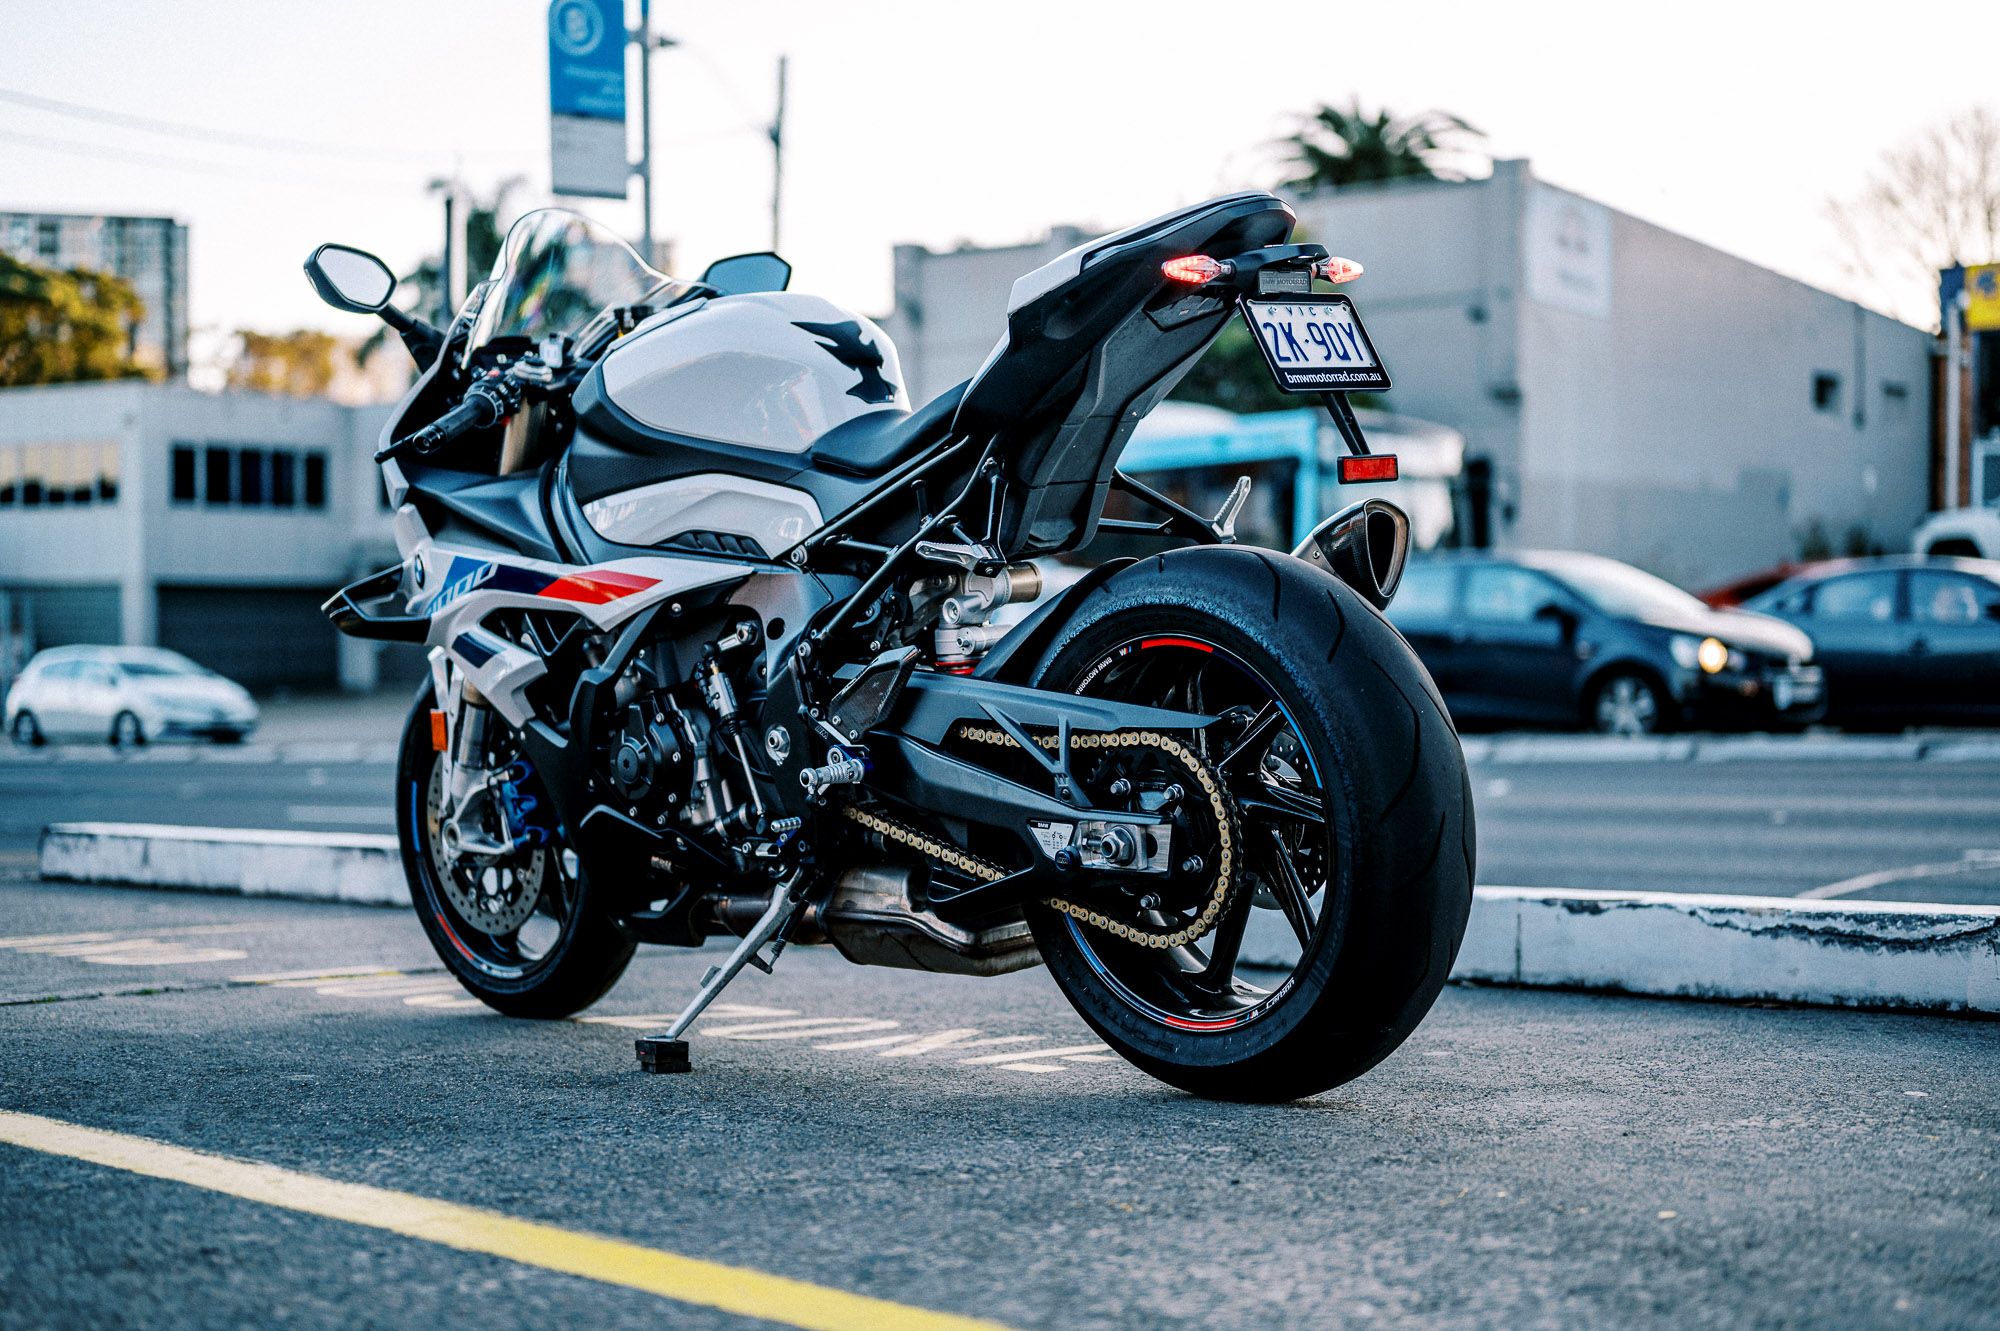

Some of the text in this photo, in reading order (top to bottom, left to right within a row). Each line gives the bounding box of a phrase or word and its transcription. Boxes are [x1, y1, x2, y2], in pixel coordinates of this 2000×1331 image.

[1286, 306, 1317, 316] VIC
[1285, 371, 1382, 383] bmwmotorrad.com.au
[1097, 656, 1113, 671] BMW
[1074, 667, 1099, 695] MOTORRA
[1266, 976, 1295, 1010] Carbon
